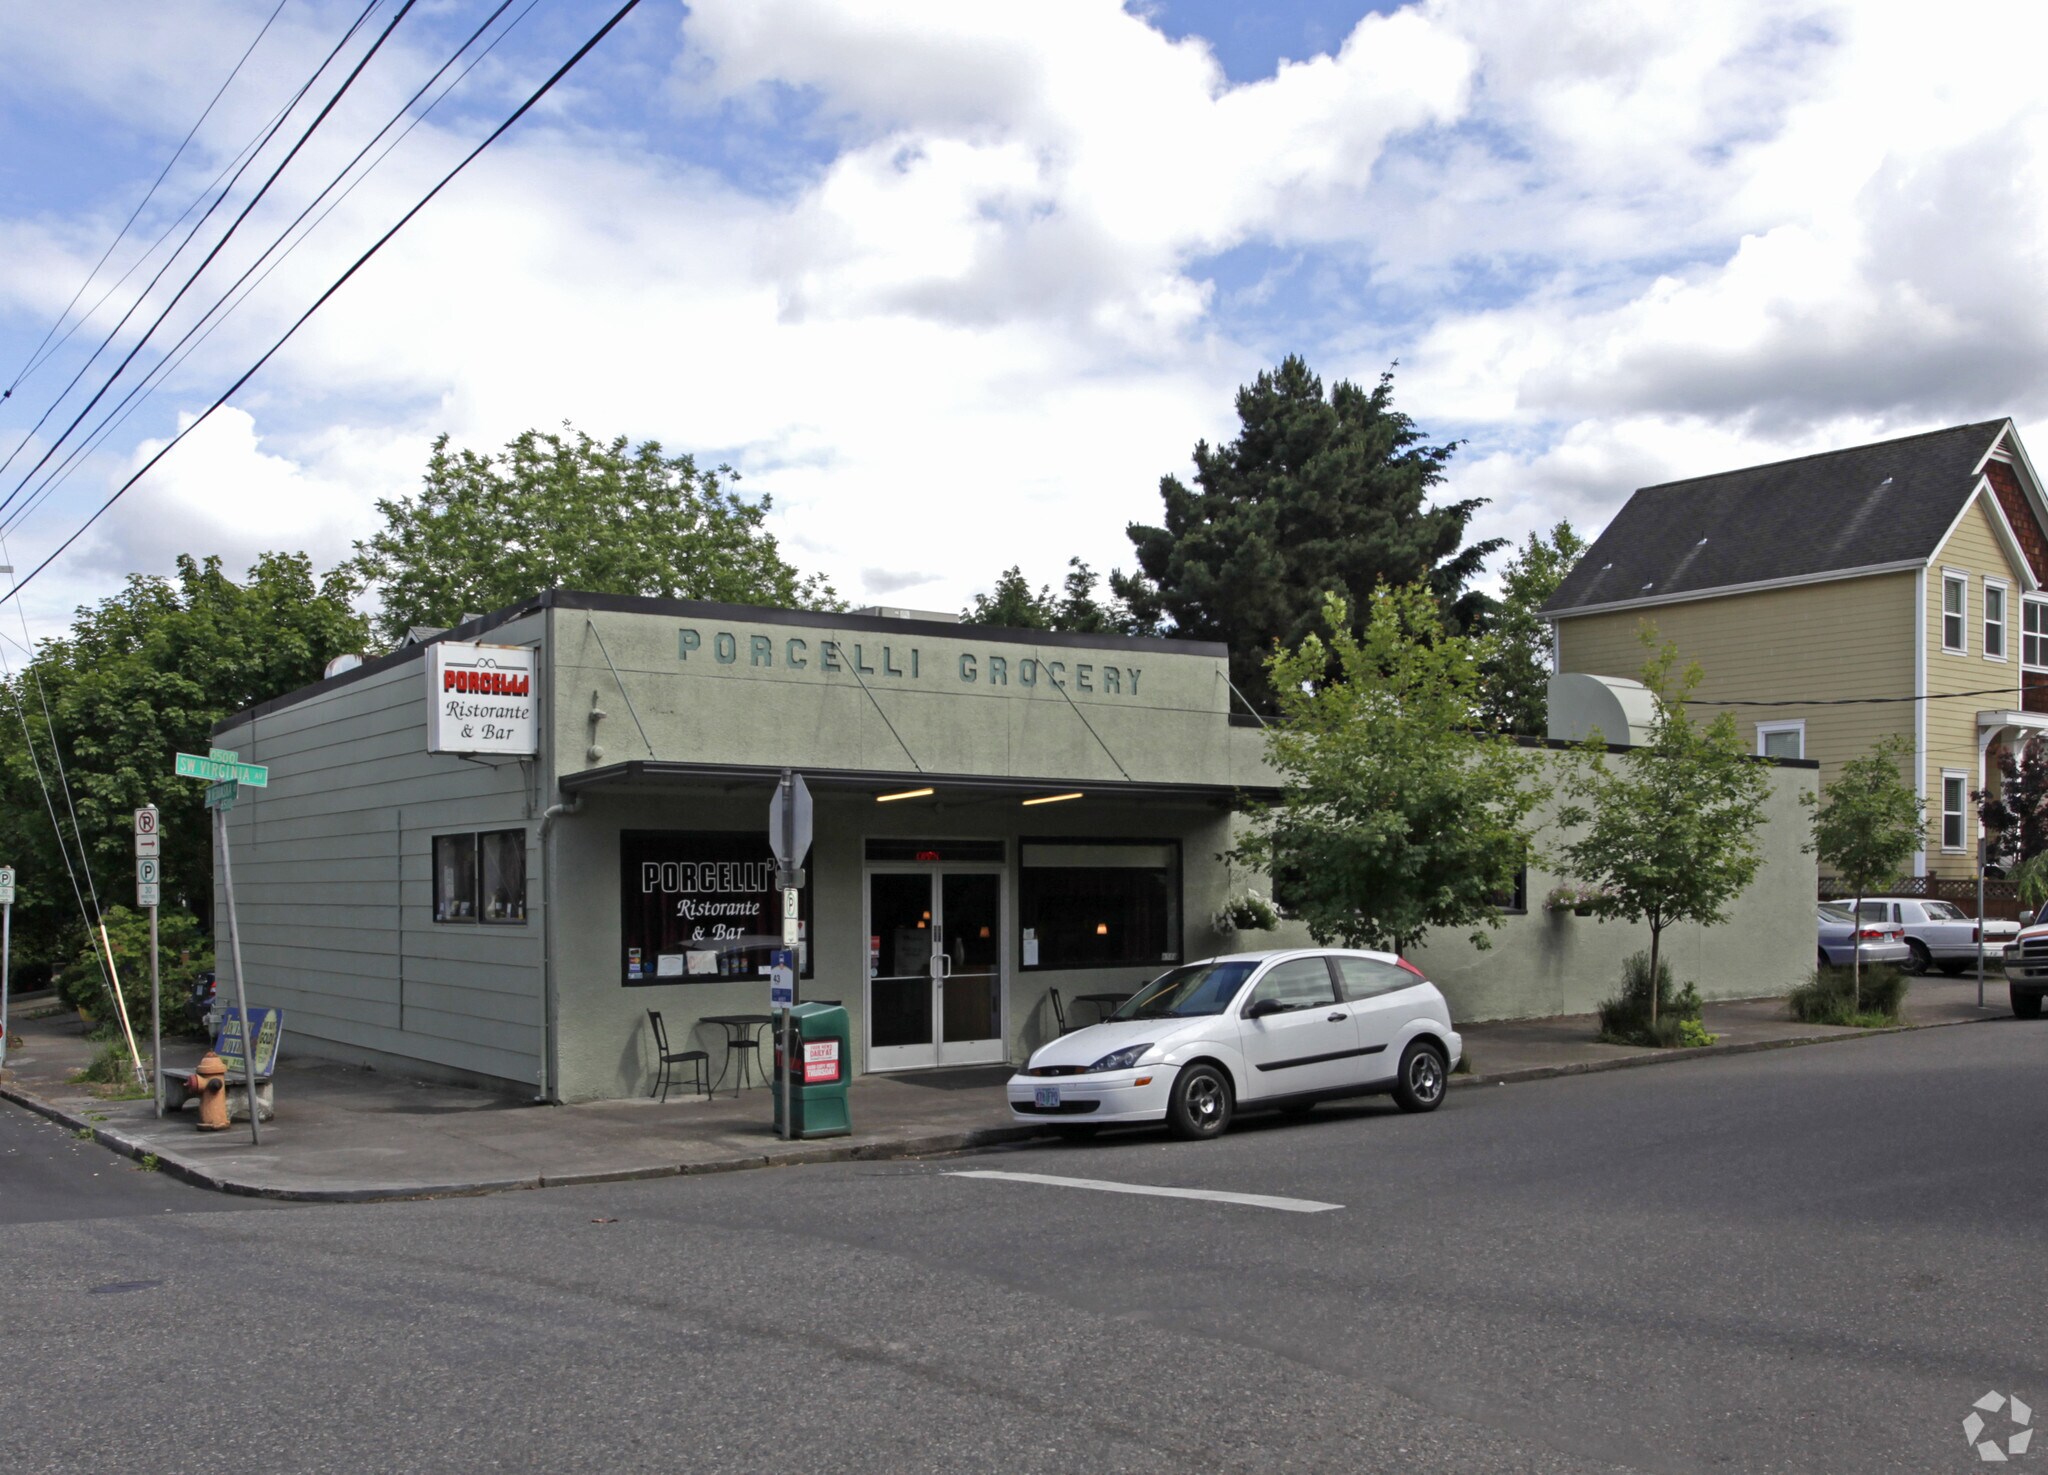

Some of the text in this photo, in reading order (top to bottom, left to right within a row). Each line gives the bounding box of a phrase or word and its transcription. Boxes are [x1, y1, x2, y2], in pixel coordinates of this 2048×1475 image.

[678, 628, 1142, 696] PORCELLI GROCERY
[444, 670, 529, 697] PORCELLI
[446, 701, 529, 720] Ristorante
[461, 724, 514, 740] & Bar
[181, 758, 196, 772] SW
[200, 762, 250, 780] VIRGINIA
[642, 858, 785, 893] PORCELLI'
[676, 899, 760, 920] Ristorante
[692, 923, 745, 941] & Bar
[773, 974, 780, 983] 43
